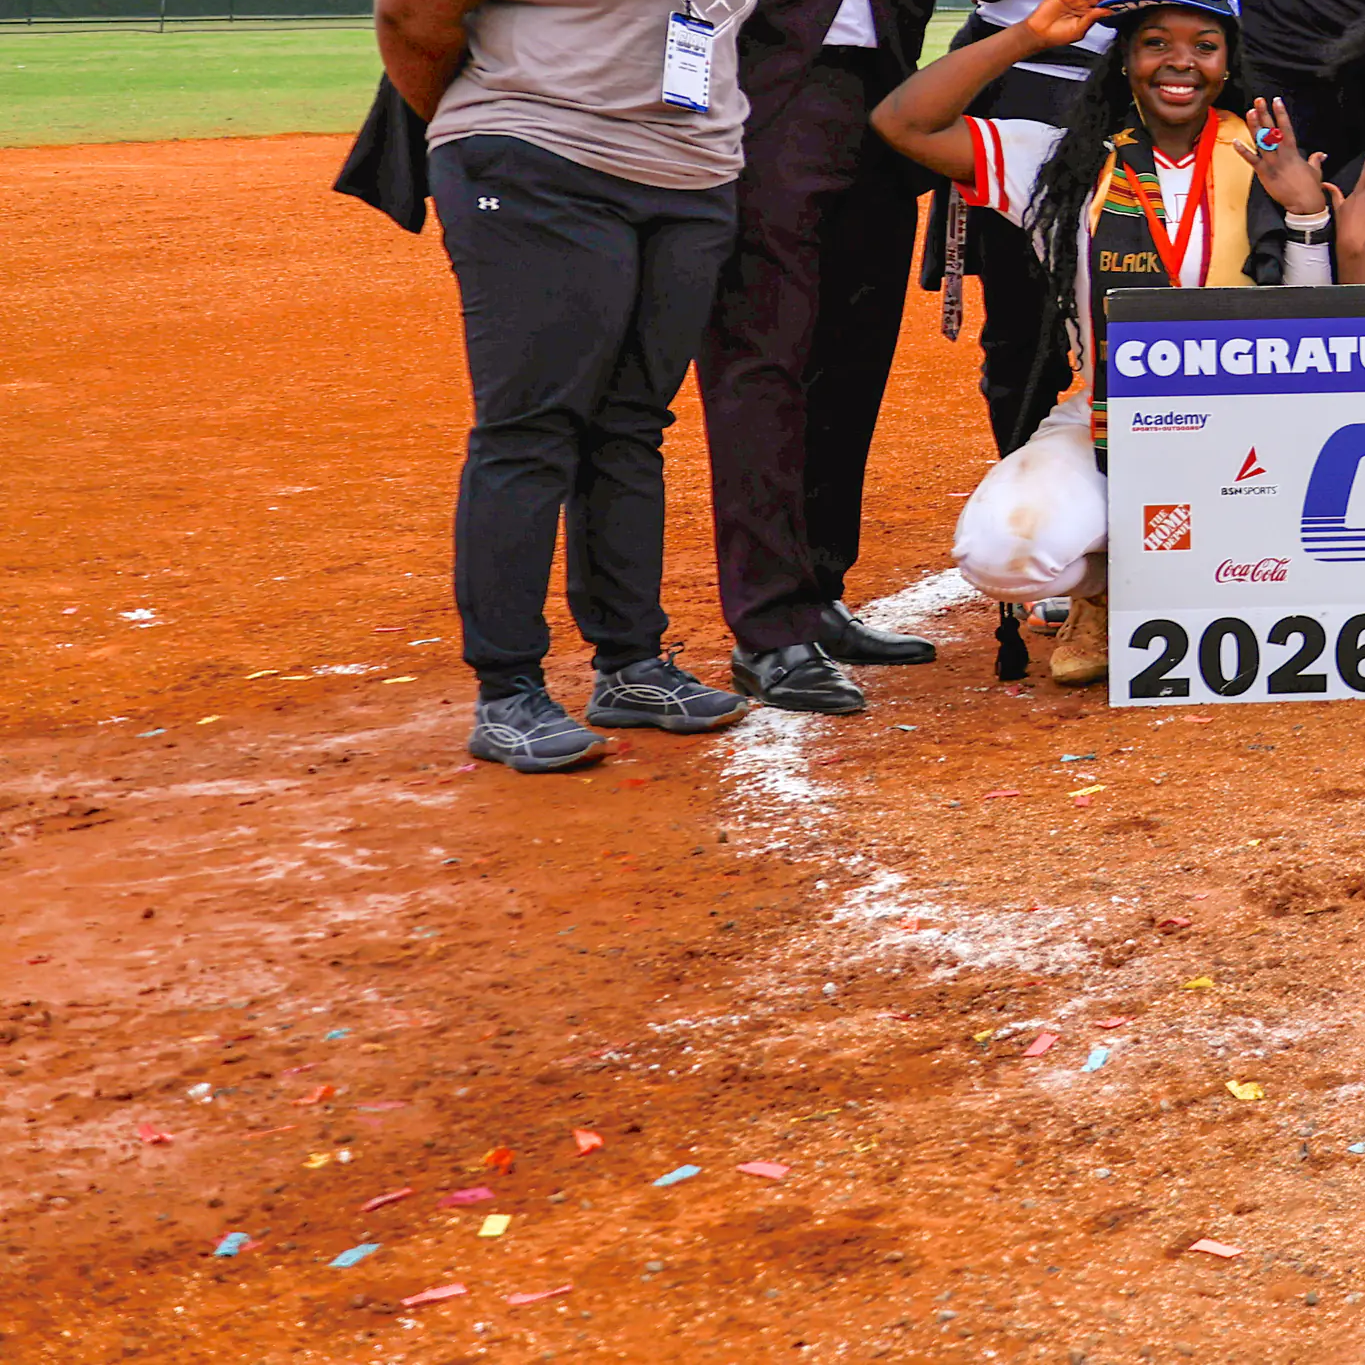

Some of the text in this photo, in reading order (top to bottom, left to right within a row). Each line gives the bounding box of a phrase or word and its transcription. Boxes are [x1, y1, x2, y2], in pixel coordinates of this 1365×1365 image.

[1100, 250, 1161, 273] BLACK
[1132, 411, 1208, 428] Academy
[1221, 486, 1277, 496] BSN SPORTS
[1144, 504, 1191, 551] HOME
[1149, 510, 1169, 528] THE
[1162, 521, 1191, 550] DEPOT
[1215, 558, 1292, 583] Coca-Cola
